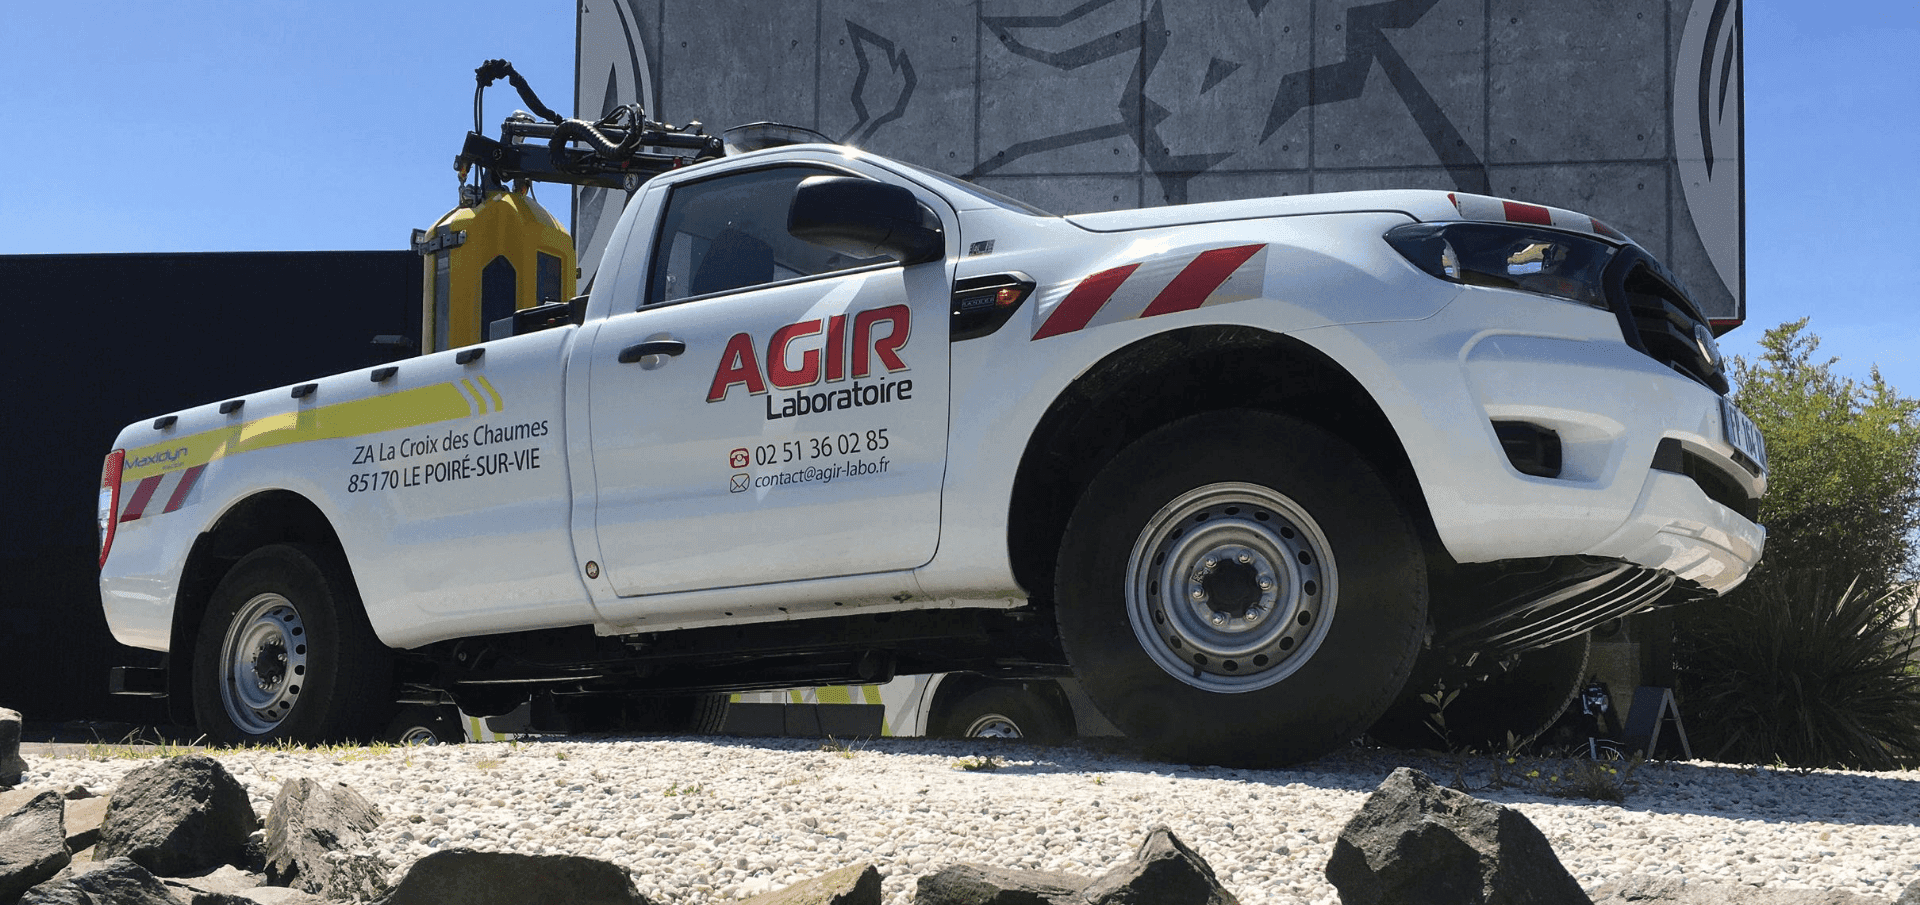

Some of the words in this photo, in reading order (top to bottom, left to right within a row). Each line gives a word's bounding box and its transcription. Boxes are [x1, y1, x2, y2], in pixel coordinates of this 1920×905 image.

[706, 304, 912, 403] AGIR
[766, 377, 912, 420] Laboratoire
[352, 445, 374, 465] ZA
[379, 443, 395, 461] La
[400, 435, 438, 457] Croix
[442, 430, 468, 451] des
[473, 420, 548, 446] Chaumes
[755, 444, 777, 466] 02
[783, 440, 802, 463] 51
[810, 436, 832, 459] 36
[837, 432, 861, 455] 02
[866, 428, 889, 451] 85
[347, 469, 399, 493] 85170
[403, 466, 421, 487] LE
[425, 448, 541, 484] POIRÉ-SUR-VIE
[755, 456, 890, 488] contact@agir-labo.fr
